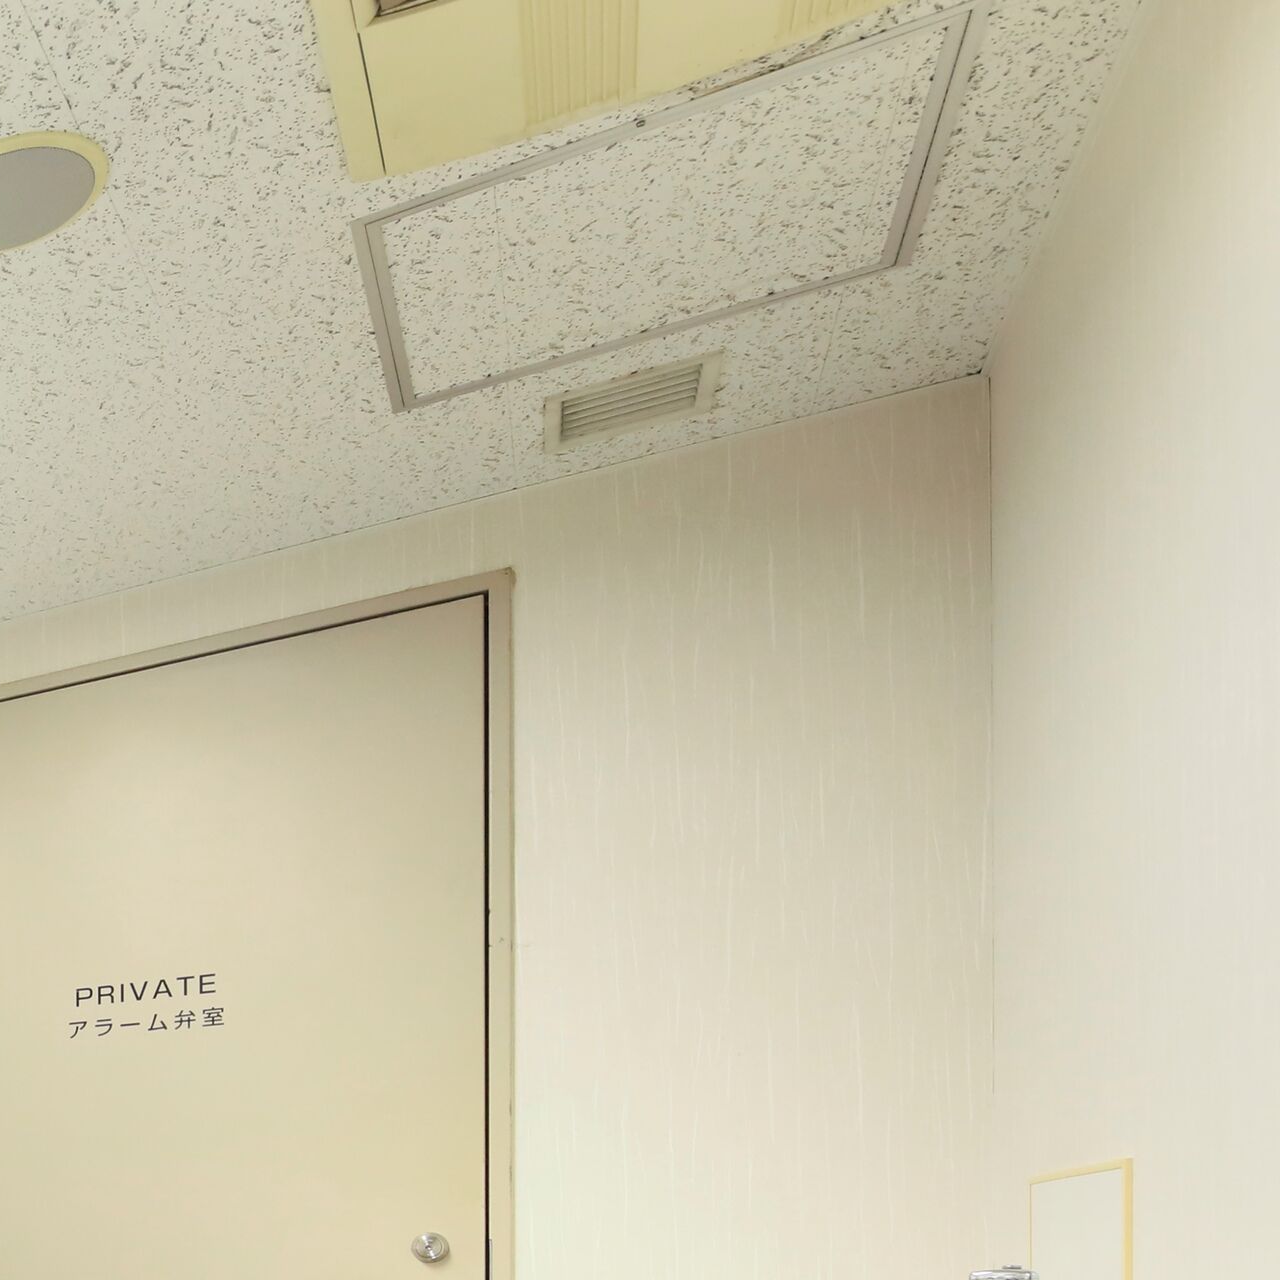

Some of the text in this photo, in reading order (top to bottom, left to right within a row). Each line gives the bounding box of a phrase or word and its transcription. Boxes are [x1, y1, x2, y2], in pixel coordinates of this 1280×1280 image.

[76, 973, 216, 1007] PRIVATE
[69, 1007, 225, 1039] アラーム弁室
